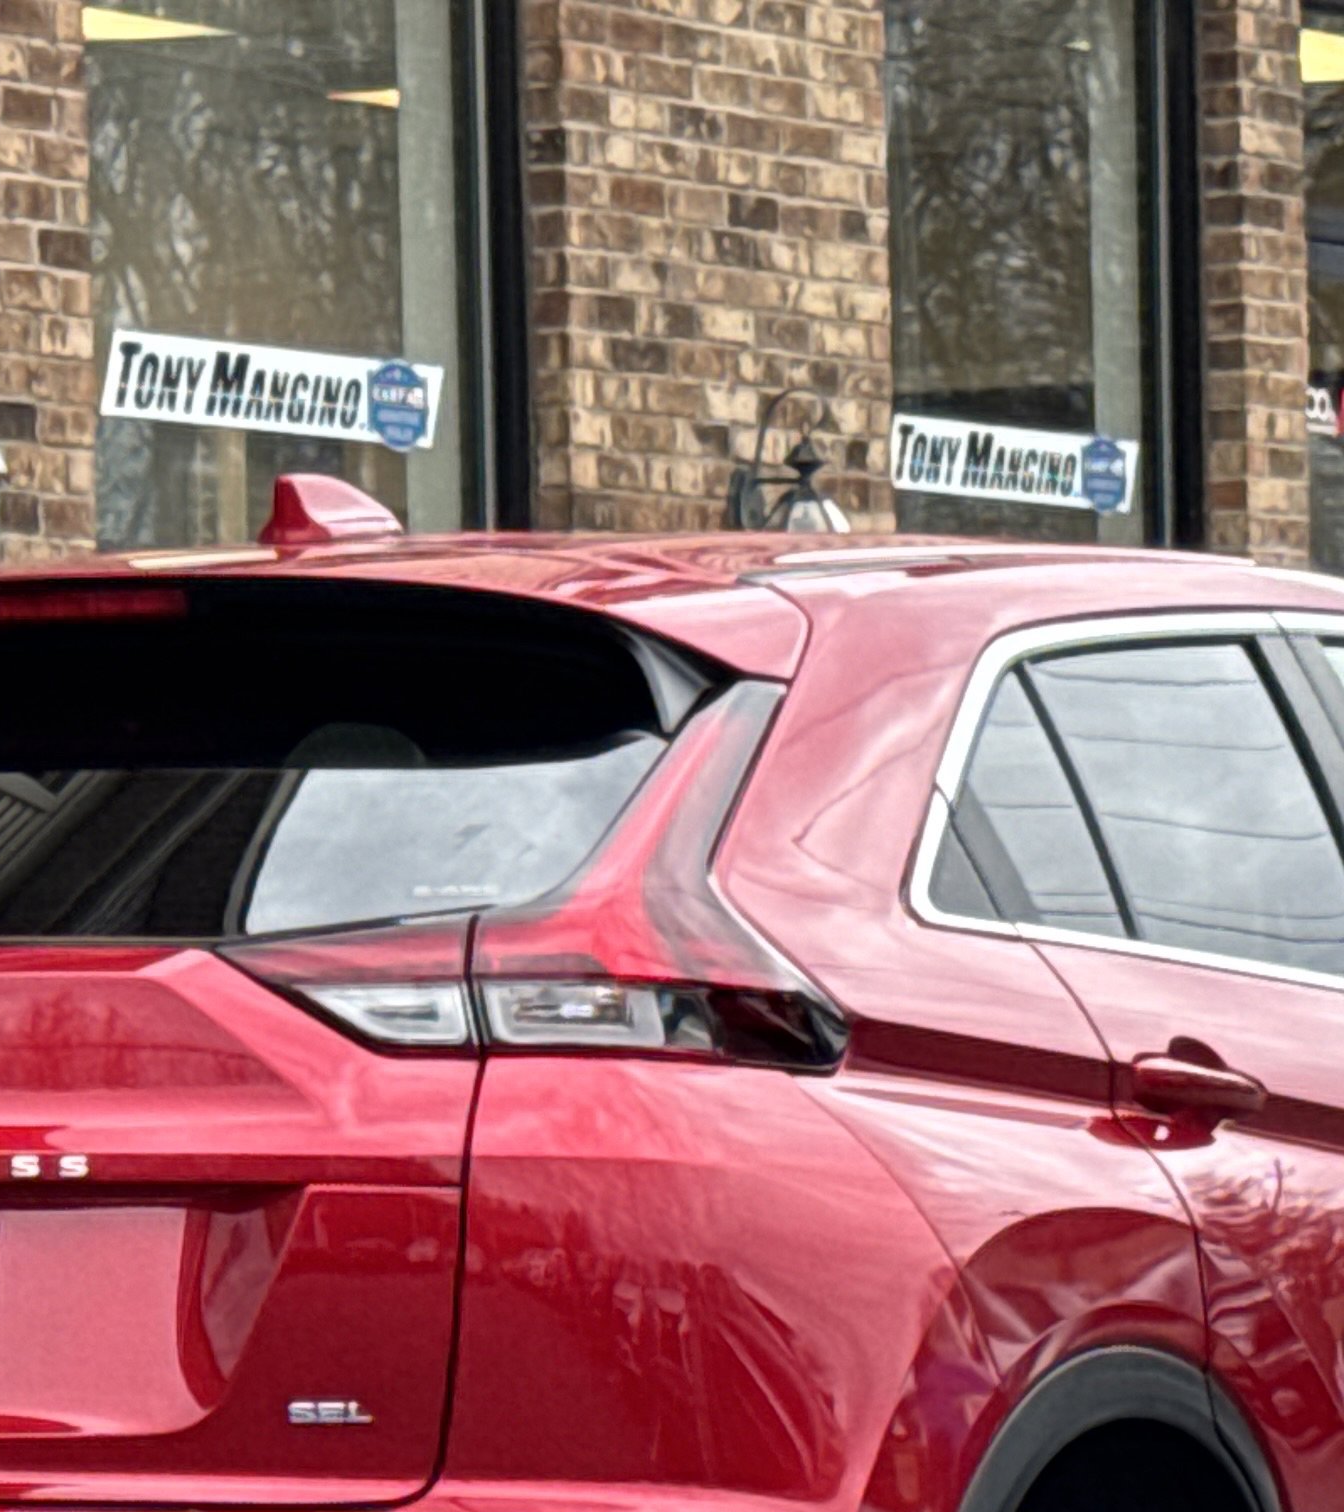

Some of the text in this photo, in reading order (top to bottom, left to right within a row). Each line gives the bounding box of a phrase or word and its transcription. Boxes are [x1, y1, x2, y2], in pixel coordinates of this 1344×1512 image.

[114, 341, 206, 415] TONY
[894, 423, 962, 486] TONY
[287, 1400, 374, 1424] SEL
